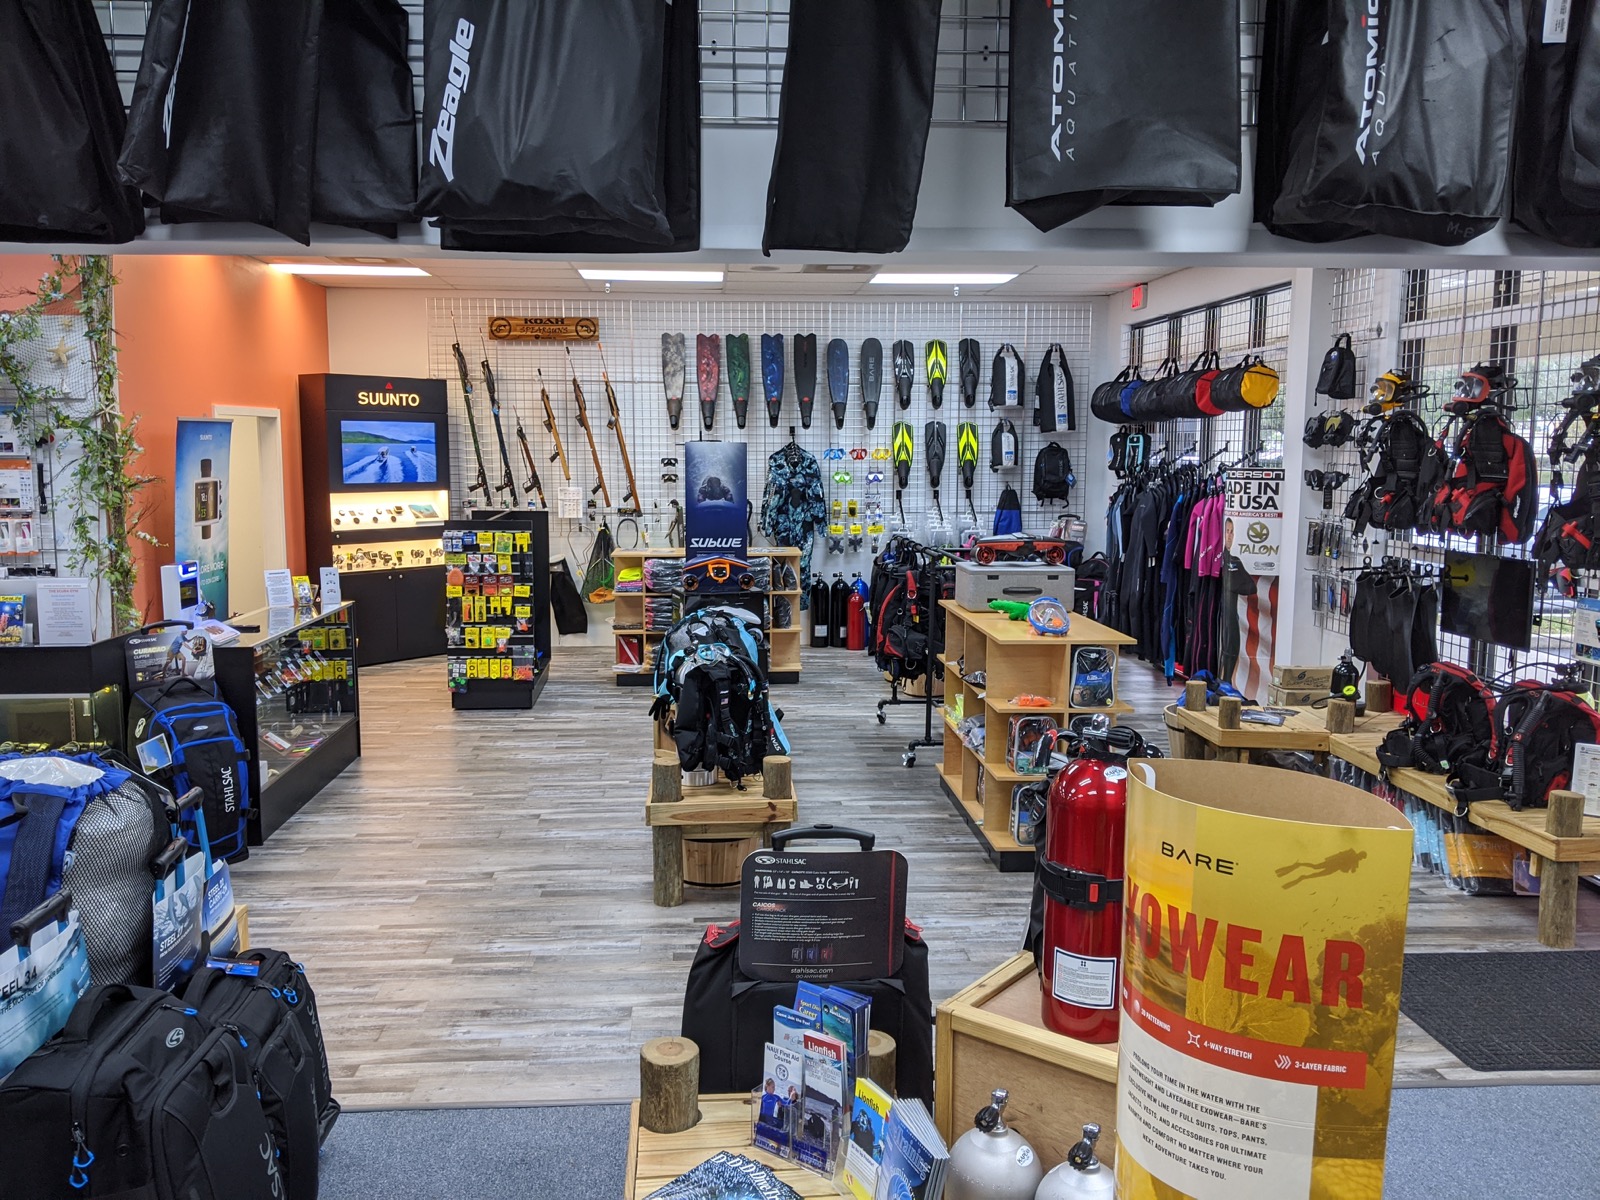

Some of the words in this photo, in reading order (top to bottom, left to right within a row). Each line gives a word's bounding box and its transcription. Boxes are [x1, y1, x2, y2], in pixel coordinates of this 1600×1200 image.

[429, 18, 475, 183] Zeagle
[357, 391, 420, 407] SUUNTO
[1057, 370, 1066, 410] STAHLSAC
[1258, 481, 1280, 496] IN
[1239, 495, 1279, 510] USA
[1238, 544, 1280, 556] TALON
[133, 646, 166, 655] CURACAO
[221, 766, 235, 813] STAHLSAC
[1161, 841, 1234, 876] BARE
[160, 934, 177, 952] STEEL
[25, 966, 38, 985] 34
[799, 1006, 818, 1018] Career
[1145, 1012, 1171, 1032] PATTERNING
[766, 1045, 779, 1055] NAUI
[779, 1049, 791, 1058] First
[791, 1053, 800, 1062] Aid
[774, 1054, 792, 1066] Course
[808, 1041, 837, 1060] Lionfish
[1203, 1041, 1223, 1052] 4-WAY
[1223, 1046, 1253, 1060] STRETCH
[1294, 1061, 1322, 1071] 3-LAYER
[1323, 1064, 1347, 1073] FABRIC
[1129, 1062, 1154, 1087] LIGHTWEIGHT
[1154, 1083, 1165, 1095] AND
[1165, 1090, 1199, 1111] LAYERABLE
[1133, 1051, 1150, 1070] PROLONG
[1150, 1067, 1164, 1079] YOUR
[1164, 1073, 1178, 1087] TIME
[1178, 1081, 1186, 1090] IN
[1186, 1085, 1199, 1096] THE
[1200, 1091, 1224, 1104] WATER
[1225, 1099, 1244, 1110] WITH
[1246, 1104, 1261, 1114] THE
[858, 1089, 880, 1113] Lionfish
[1128, 1075, 1147, 1097] EXCLUSIVE
[1146, 1093, 1157, 1105] NEW
[1157, 1099, 1170, 1113] LINE
[1170, 1107, 1179, 1116] OF
[1179, 1112, 1195, 1124] FULL
[1127, 1103, 1143, 1123] WARMTH
[1142, 1118, 1152, 1131] AND
[1152, 1125, 1177, 1146] COMFORT
[1178, 1141, 1187, 1151] NO
[1188, 1146, 1215, 1162] MATTER
[1216, 1156, 1242, 1170] WHERE
[1243, 1164, 1264, 1175] YOUR
[1158, 1115, 1170, 1127] AND
[1170, 1121, 1214, 1146] ACCESSORIES
[1215, 1141, 1229, 1151] FOR
[1230, 1146, 1267, 1161] ULTIMATE
[1142, 1133, 1154, 1146] NEXT
[1154, 1144, 1187, 1166] ADVENTURE
[1187, 1160, 1209, 1175] TAKES
